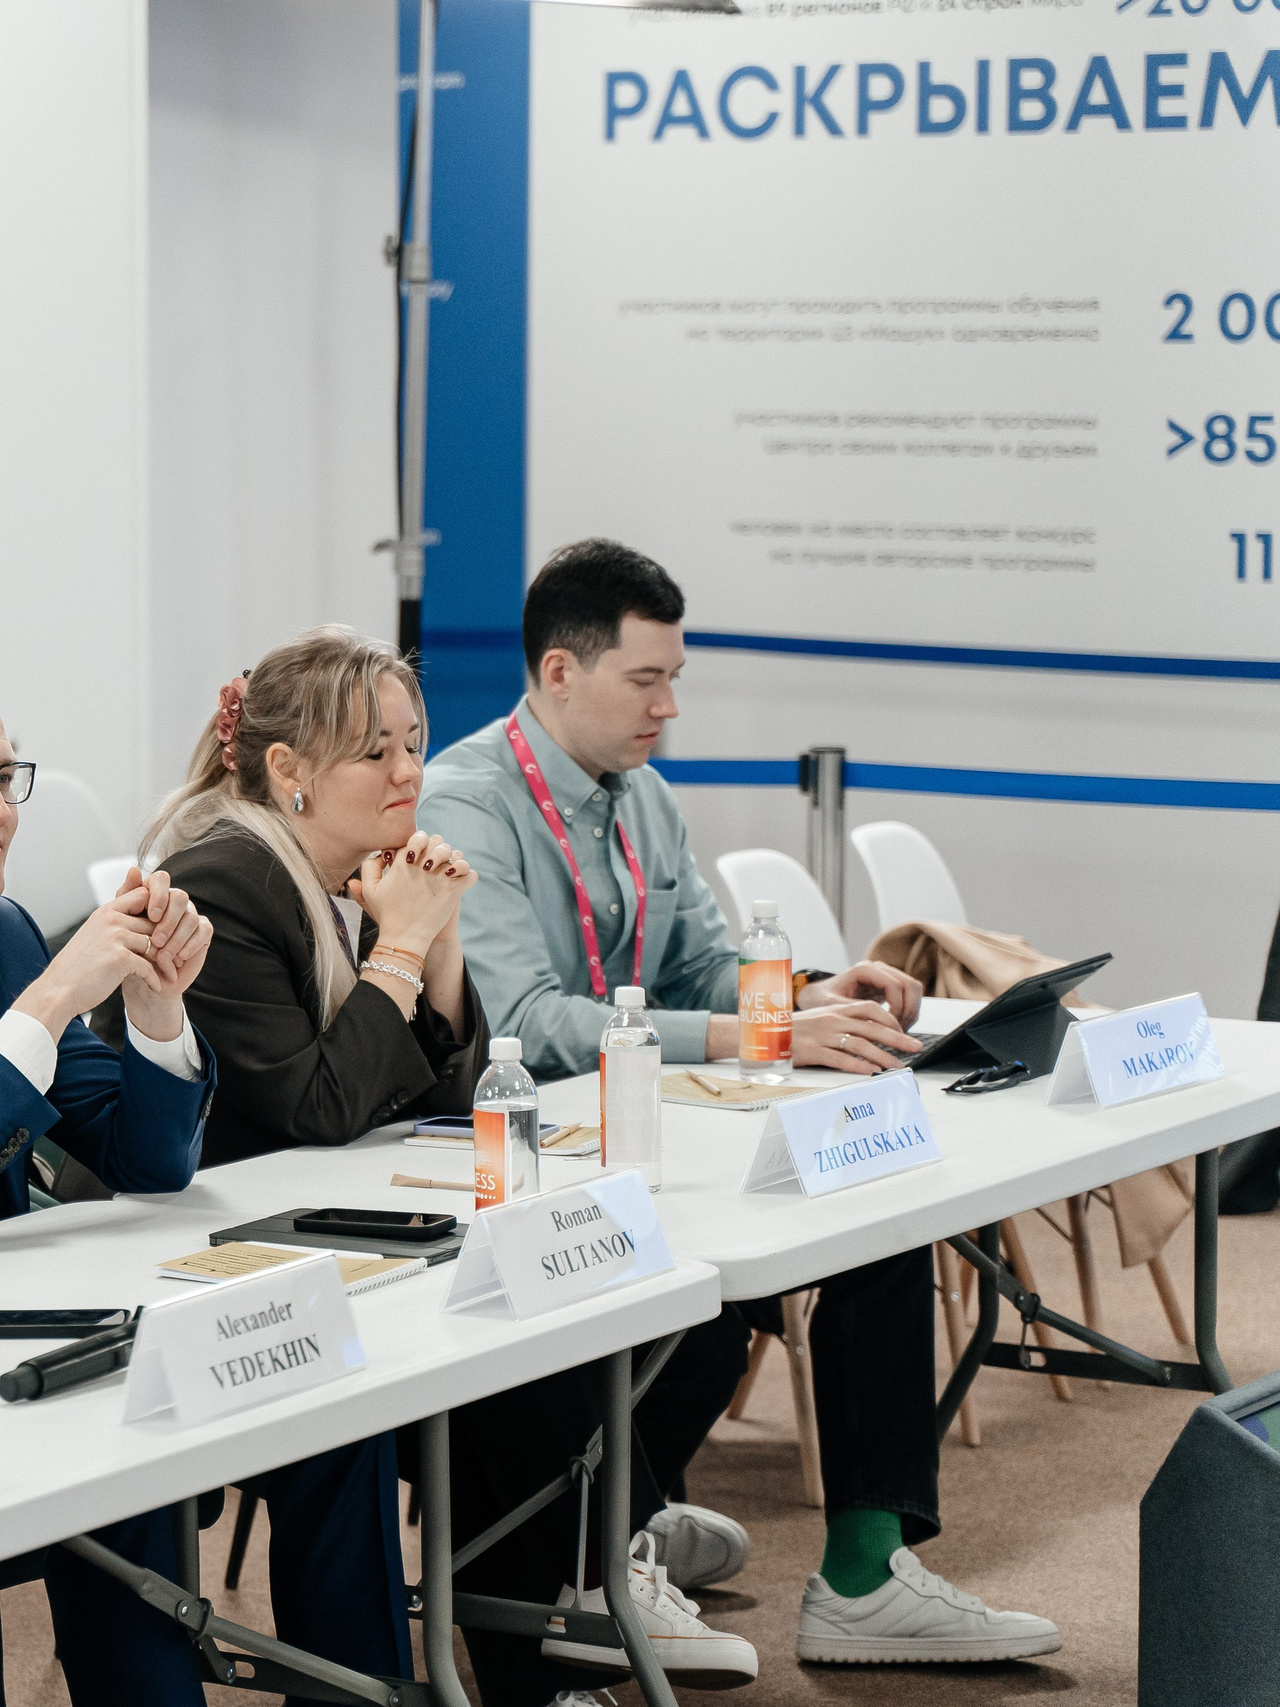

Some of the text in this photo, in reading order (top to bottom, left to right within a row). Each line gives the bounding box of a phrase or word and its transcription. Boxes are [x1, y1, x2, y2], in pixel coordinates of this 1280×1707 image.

[603, 49, 1280, 142] РАСКРЫВАЕМ
[739, 1009, 793, 1024] BUSINES
[740, 990, 765, 1009] WE
[1136, 1020, 1166, 1040] Oleg
[1122, 1041, 1195, 1079] MAKAROV
[843, 1102, 876, 1123] Anna
[814, 1123, 926, 1174] ZHIGULSKAYA
[550, 1204, 603, 1233] Roman
[541, 1229, 636, 1281] SULTANOV
[216, 1301, 293, 1343] Alexander
[209, 1333, 322, 1390] VEDEKHIN
